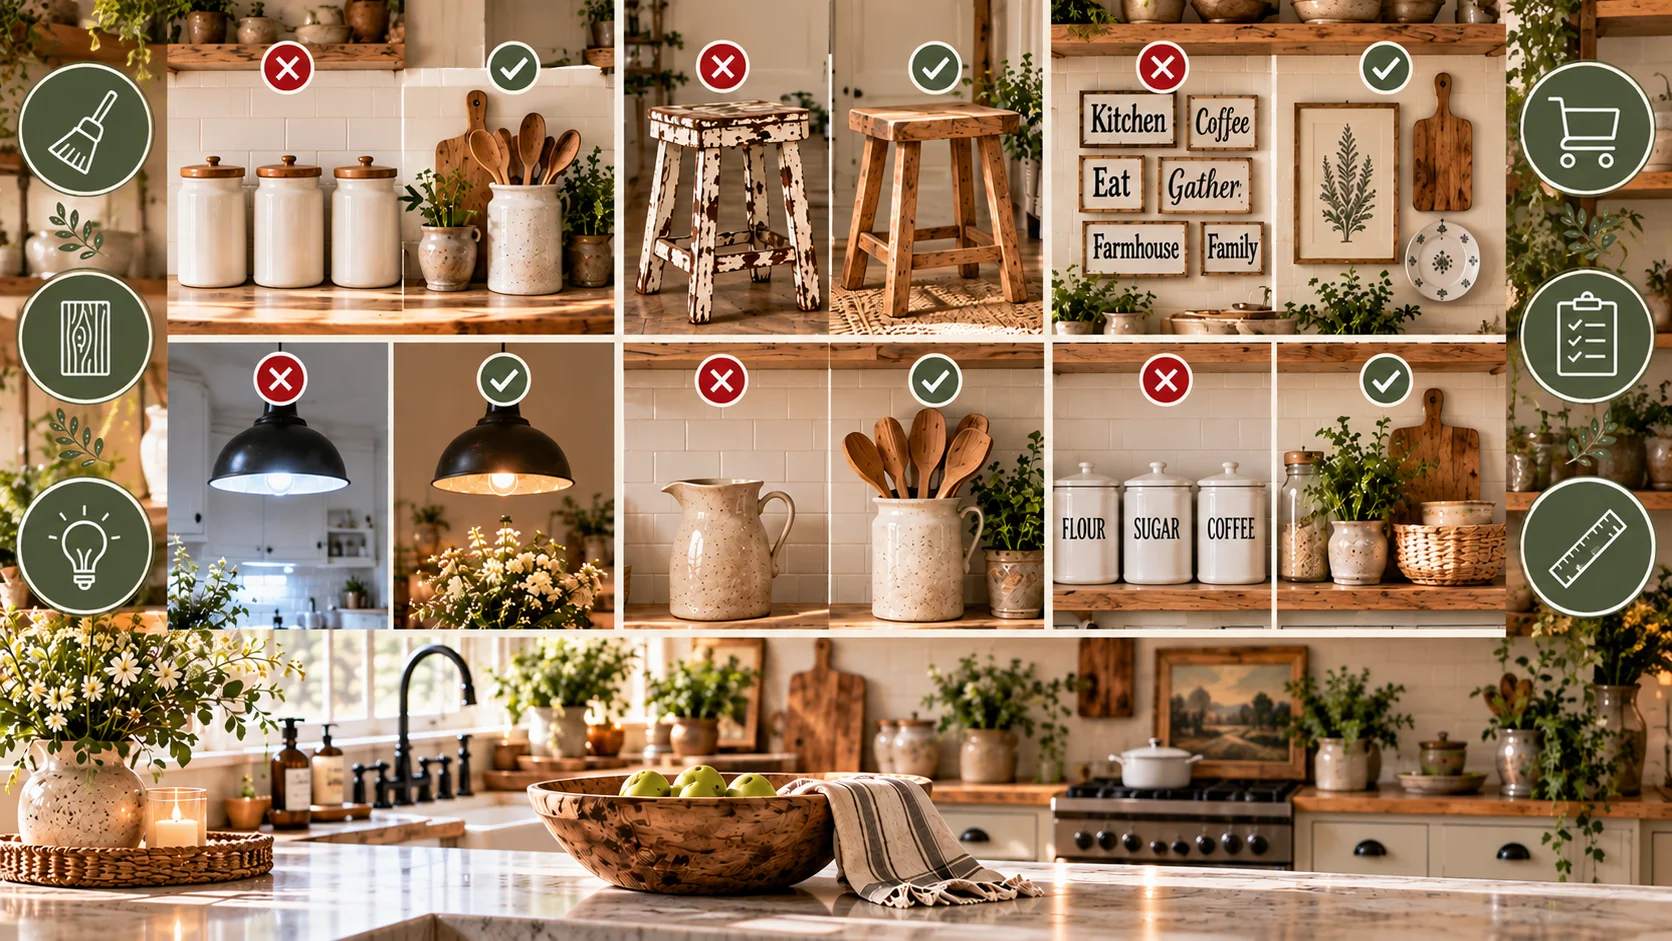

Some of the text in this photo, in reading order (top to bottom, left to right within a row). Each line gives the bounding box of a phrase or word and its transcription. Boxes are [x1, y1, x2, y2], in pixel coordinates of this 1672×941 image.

[1091, 103, 1167, 133] Kitchen
[1195, 106, 1250, 142] Coffee
[1093, 166, 1131, 197] Eat
[1093, 233, 1180, 259] Farmhouse
[1207, 232, 1258, 265] Family
[1062, 517, 1106, 540] FLOUR
[1133, 517, 1180, 540] SUGAR
[1207, 517, 1255, 540] COFFEE
